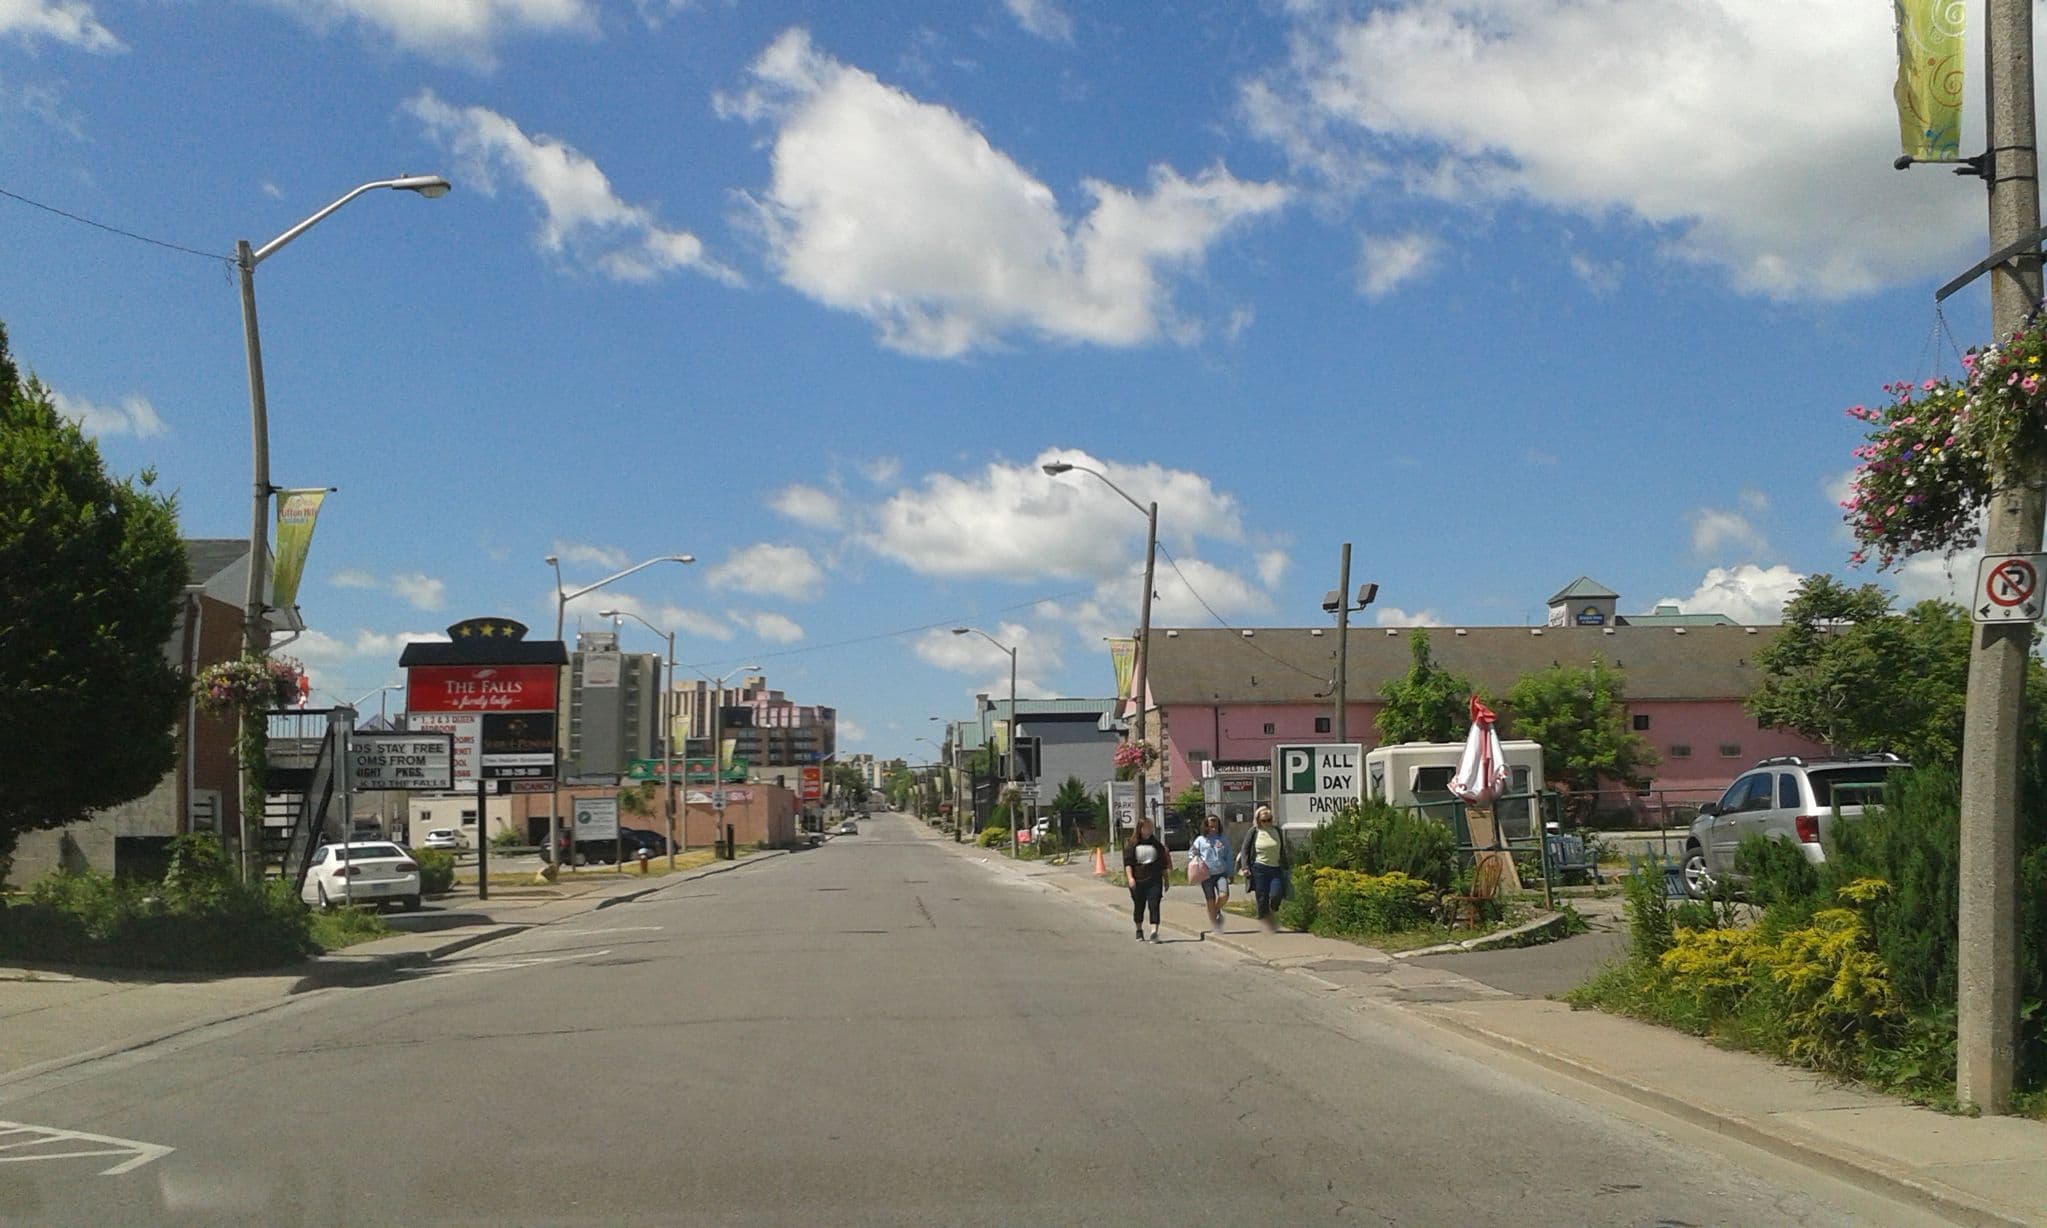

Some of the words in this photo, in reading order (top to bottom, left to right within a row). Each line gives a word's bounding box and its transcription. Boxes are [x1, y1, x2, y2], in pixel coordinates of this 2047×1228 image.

[445, 680, 475, 693] THE
[482, 680, 522, 693] FALLS
[377, 743, 406, 754] STAY
[413, 743, 445, 754] FREE
[390, 755, 427, 766] FROM
[1286, 750, 1309, 791] P
[1322, 754, 1354, 768] ALL
[1323, 776, 1352, 790] DAY
